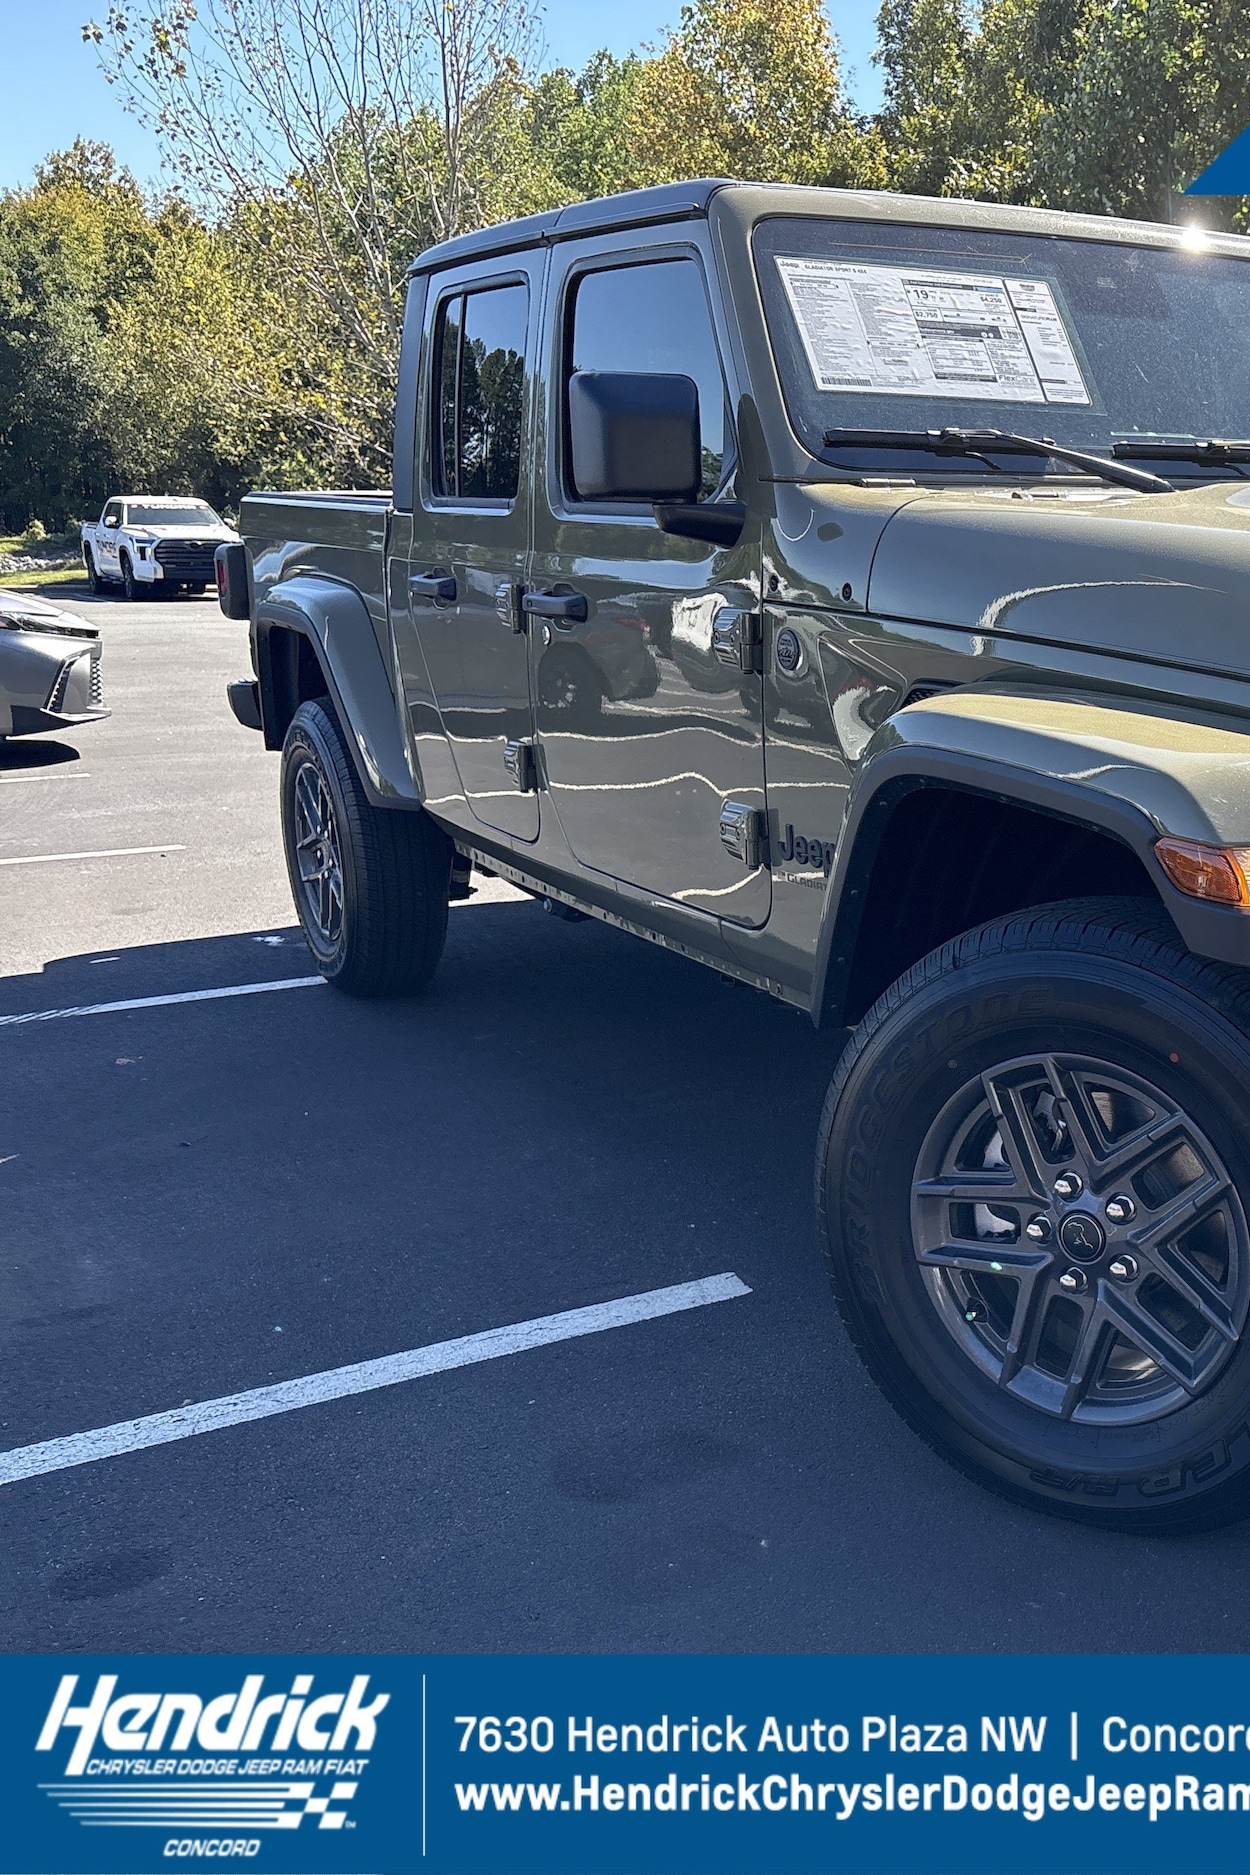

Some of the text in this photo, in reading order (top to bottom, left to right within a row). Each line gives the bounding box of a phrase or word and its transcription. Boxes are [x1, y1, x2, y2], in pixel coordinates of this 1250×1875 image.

[913, 289, 929, 299] 19
[999, 374, 1035, 383] FlexCare
[777, 823, 836, 879] Jeep
[786, 873, 828, 892] GLADIAT
[844, 984, 1056, 1305] BRIDGESTONE
